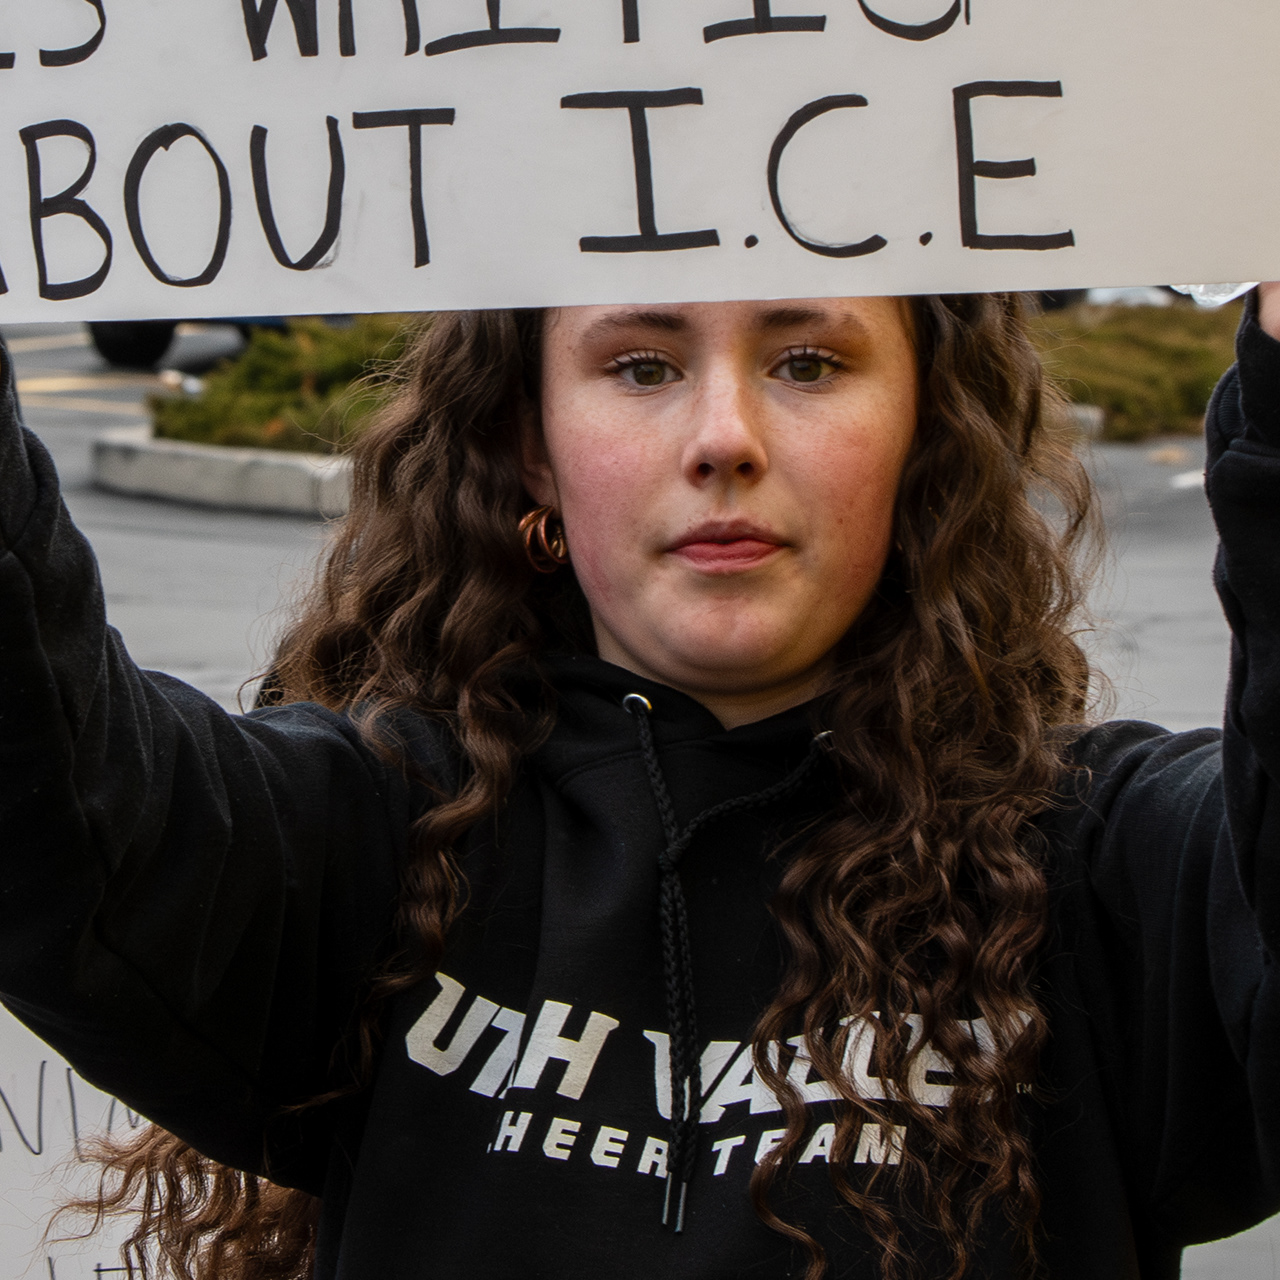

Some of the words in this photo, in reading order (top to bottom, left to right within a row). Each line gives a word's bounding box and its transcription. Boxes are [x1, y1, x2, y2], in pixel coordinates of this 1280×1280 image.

[561, 81, 1074, 258] I.C.E
[405, 970, 619, 1101] UTH
[487, 1110, 670, 1179] HEER
[712, 1121, 908, 1177] TEAM
